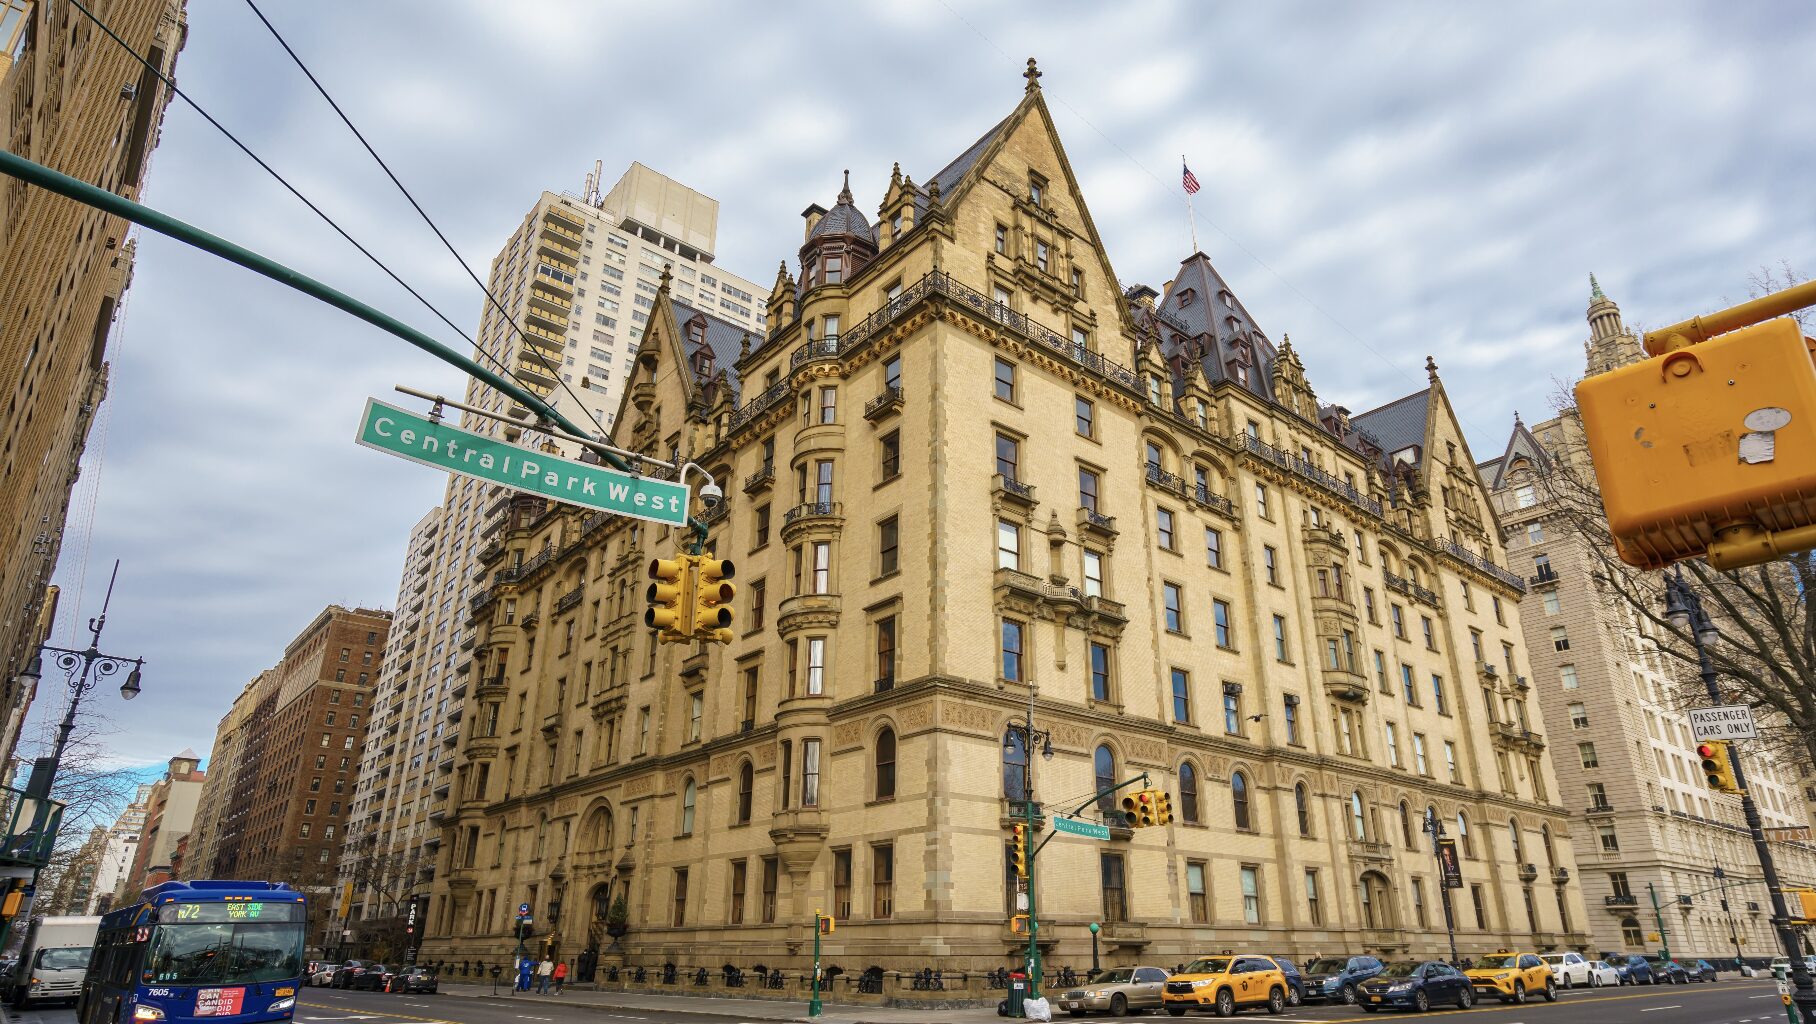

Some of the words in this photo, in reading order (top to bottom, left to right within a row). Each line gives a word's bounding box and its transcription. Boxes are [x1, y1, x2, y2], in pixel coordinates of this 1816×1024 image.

[374, 417, 511, 473] Central
[520, 460, 597, 497] Park
[608, 481, 680, 513] West
[1693, 709, 1748, 723] PASSENGER
[1697, 724, 1722, 736] CARS
[1727, 722, 1750, 733] ONLY
[1779, 830, 1793, 841] 72
[1797, 829, 1809, 840] ST
[227, 903, 246, 911] EAST
[247, 903, 263, 911] SIDE
[408, 903, 417, 925] PARK
[148, 988, 170, 996] 7605
[200, 992, 219, 1000] CAN
